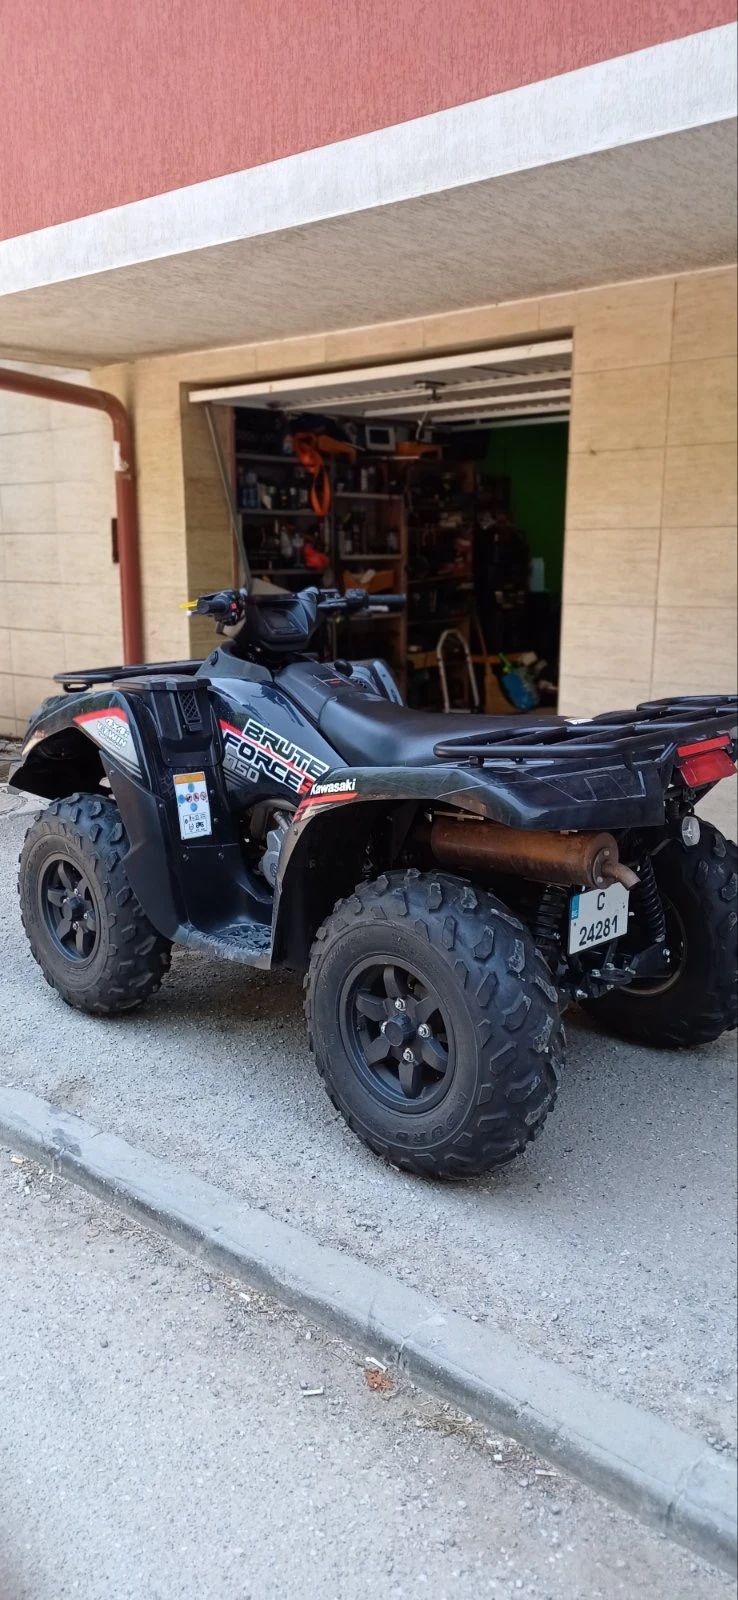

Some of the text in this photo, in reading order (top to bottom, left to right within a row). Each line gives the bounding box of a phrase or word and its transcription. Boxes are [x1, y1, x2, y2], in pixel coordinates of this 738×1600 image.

[223, 729, 304, 793] FORCE
[242, 719, 330, 780] BRUTE
[223, 754, 260, 783] 750
[310, 778, 357, 796] Kawasaki
[597, 892, 606, 910] C
[579, 914, 618, 946] 24281
